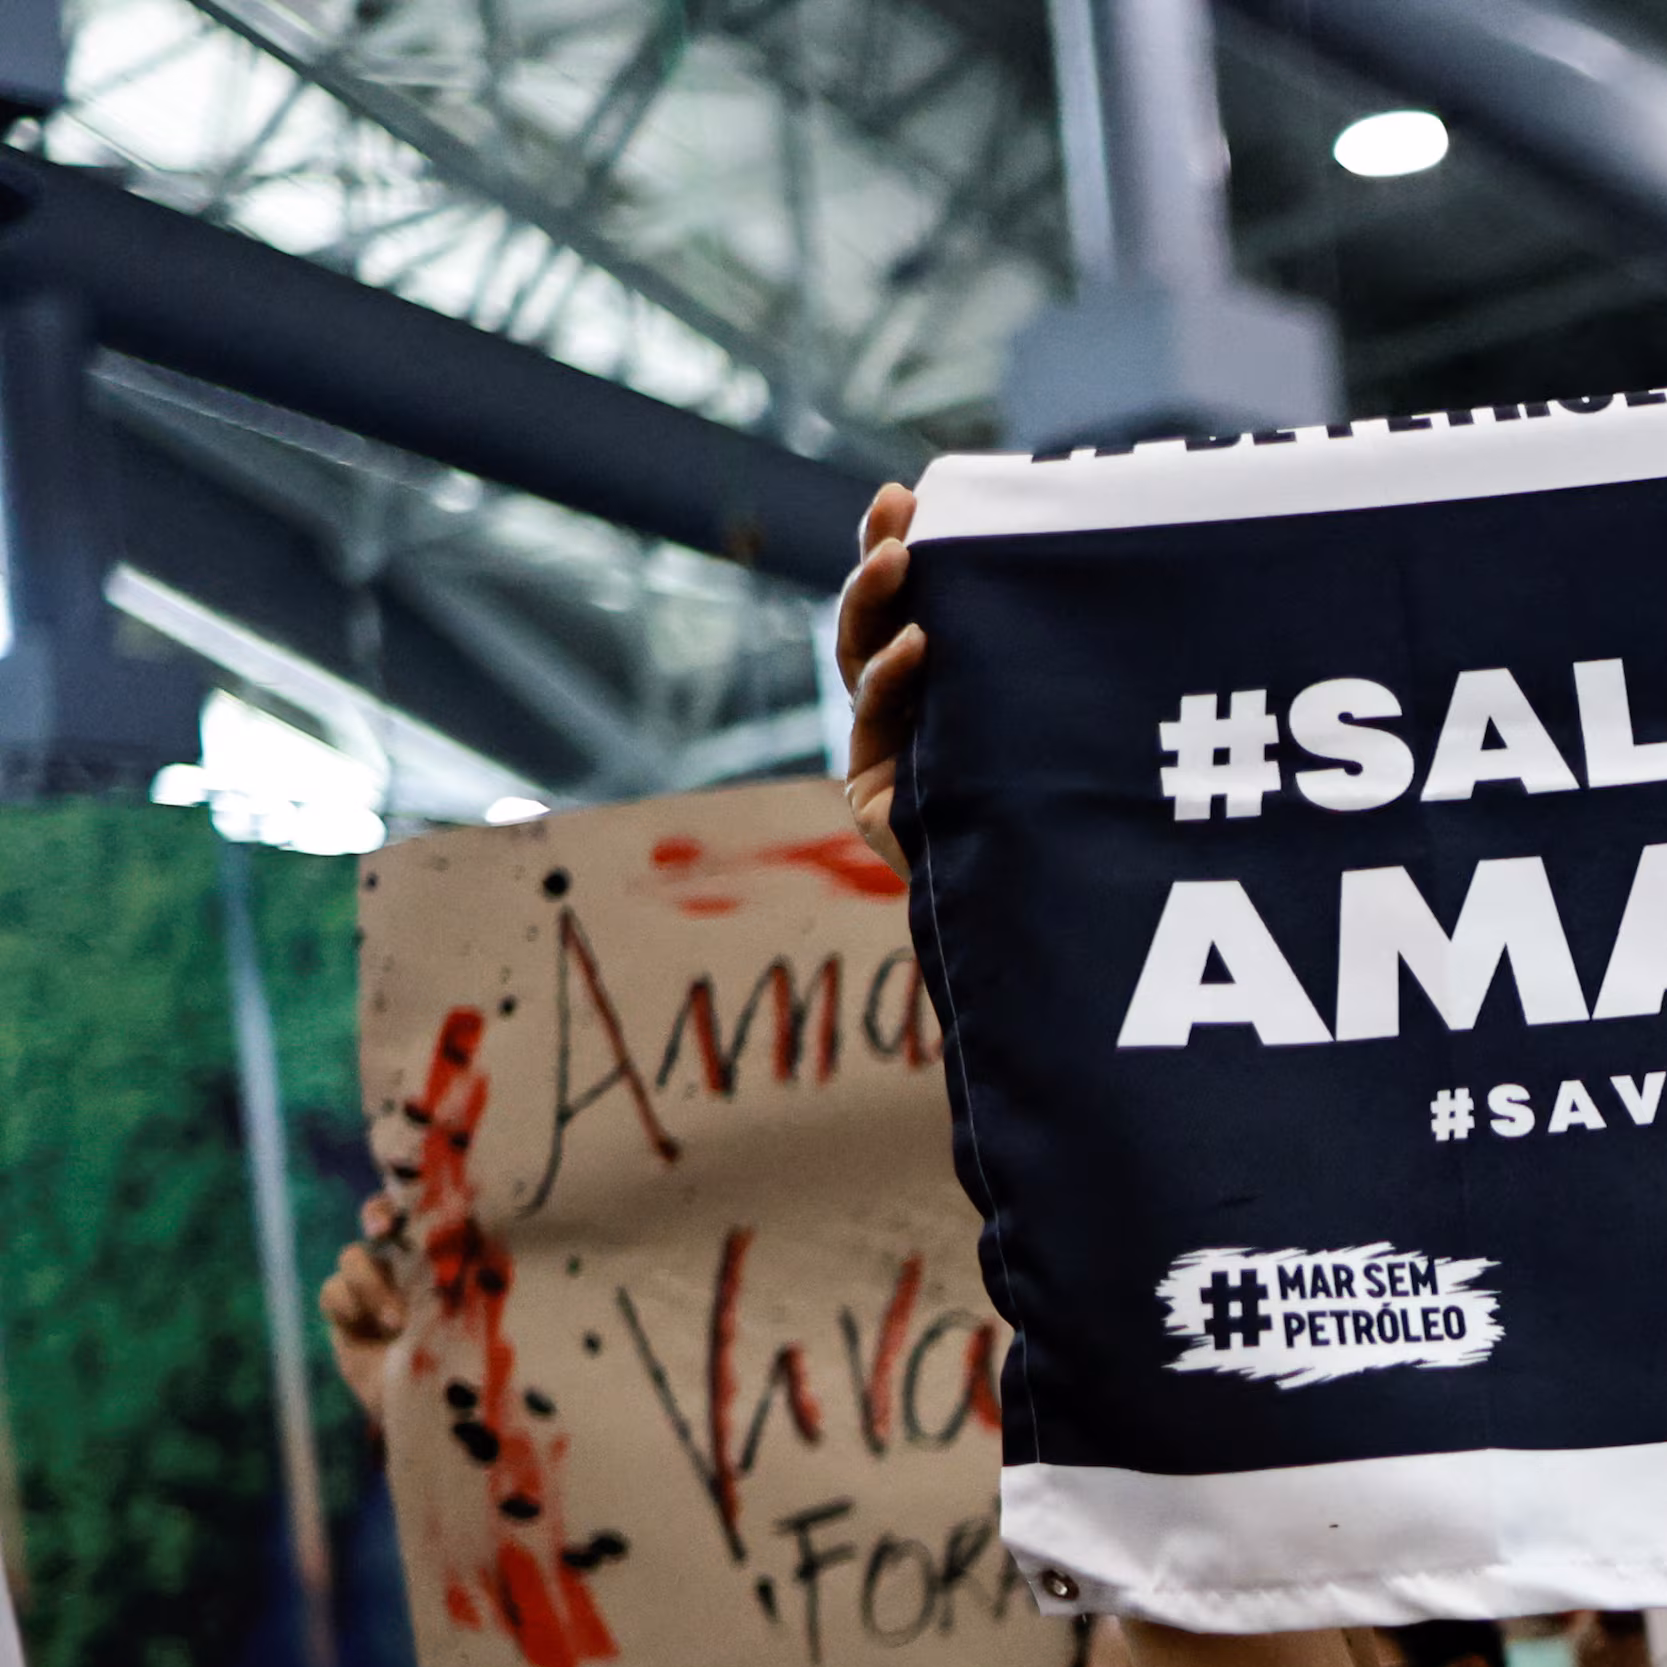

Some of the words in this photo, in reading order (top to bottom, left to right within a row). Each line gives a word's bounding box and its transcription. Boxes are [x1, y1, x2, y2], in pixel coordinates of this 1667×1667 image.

[1277, 1263, 1357, 1301] MAR
[1363, 1260, 1439, 1299] SEM
[1283, 1303, 1467, 1349] PETRÓLEO
